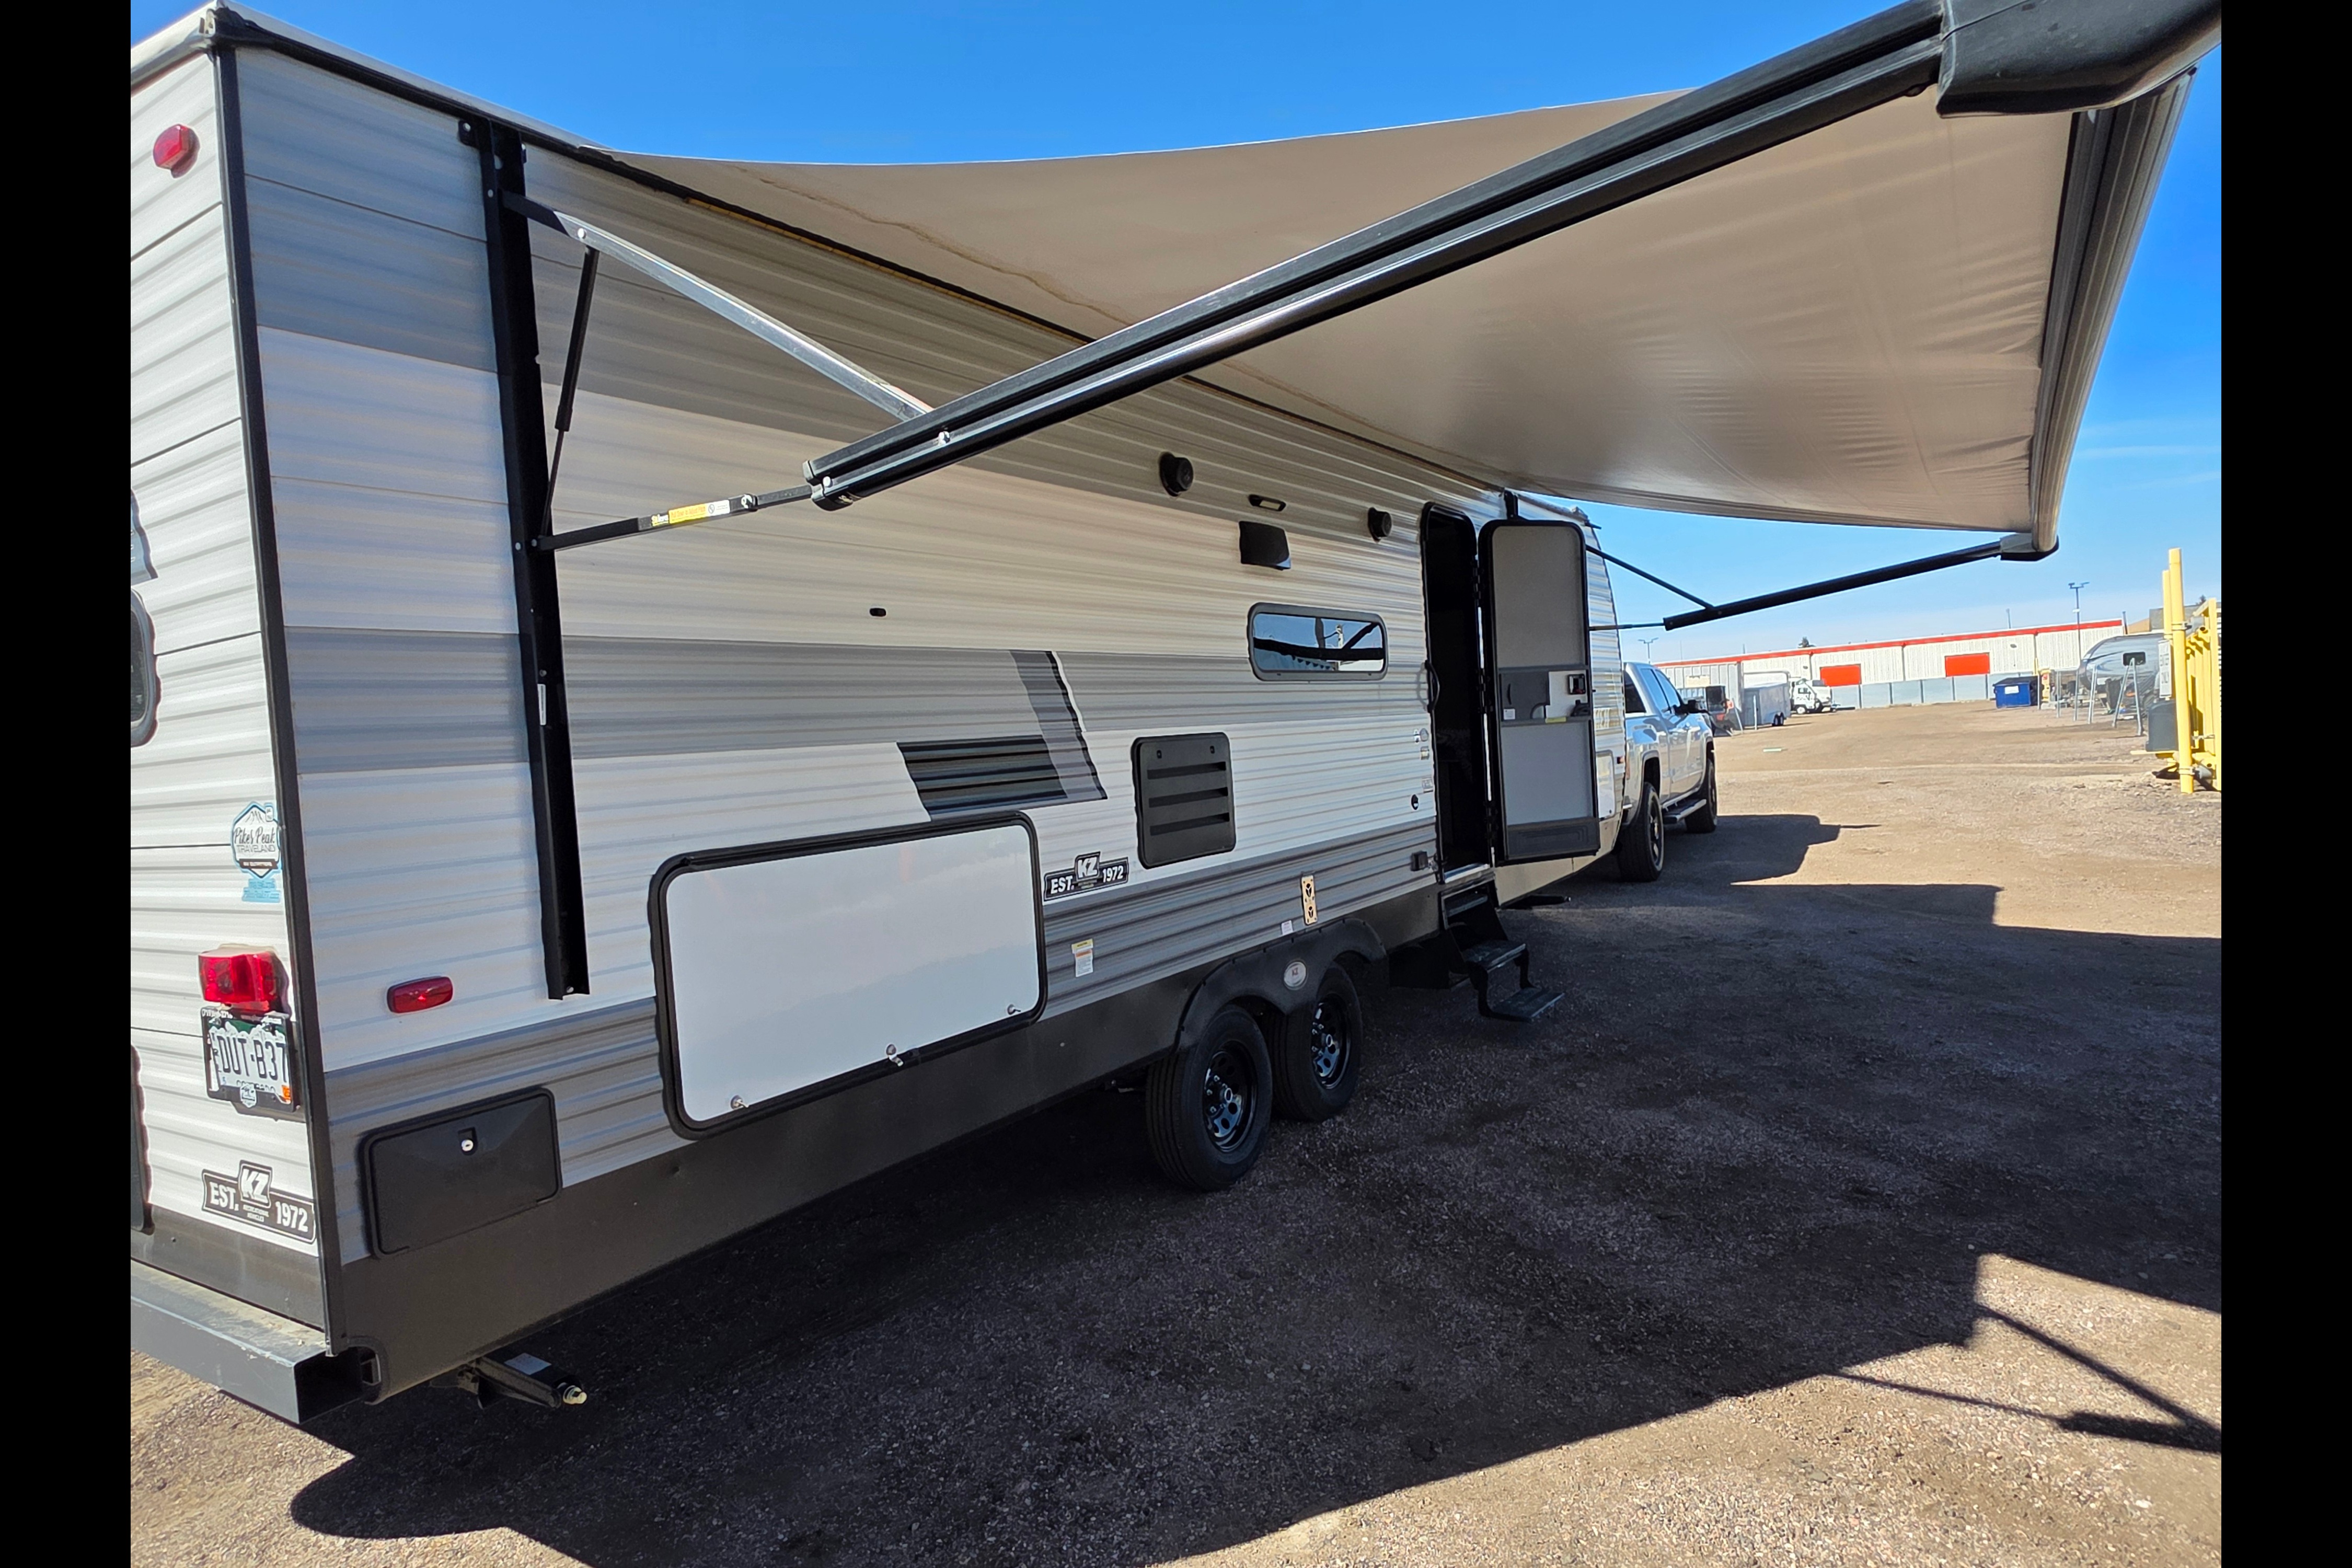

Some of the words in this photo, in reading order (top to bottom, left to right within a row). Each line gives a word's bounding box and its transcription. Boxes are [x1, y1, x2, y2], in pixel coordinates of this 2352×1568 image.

[255, 826, 275, 845] Peak
[1051, 875, 1074, 894] EST.
[1078, 857, 1098, 878] KZ
[1102, 866, 1123, 883] 1972
[210, 1181, 239, 1211] EST.
[241, 1168, 270, 1203] KZ
[275, 1201, 308, 1232] 1972
